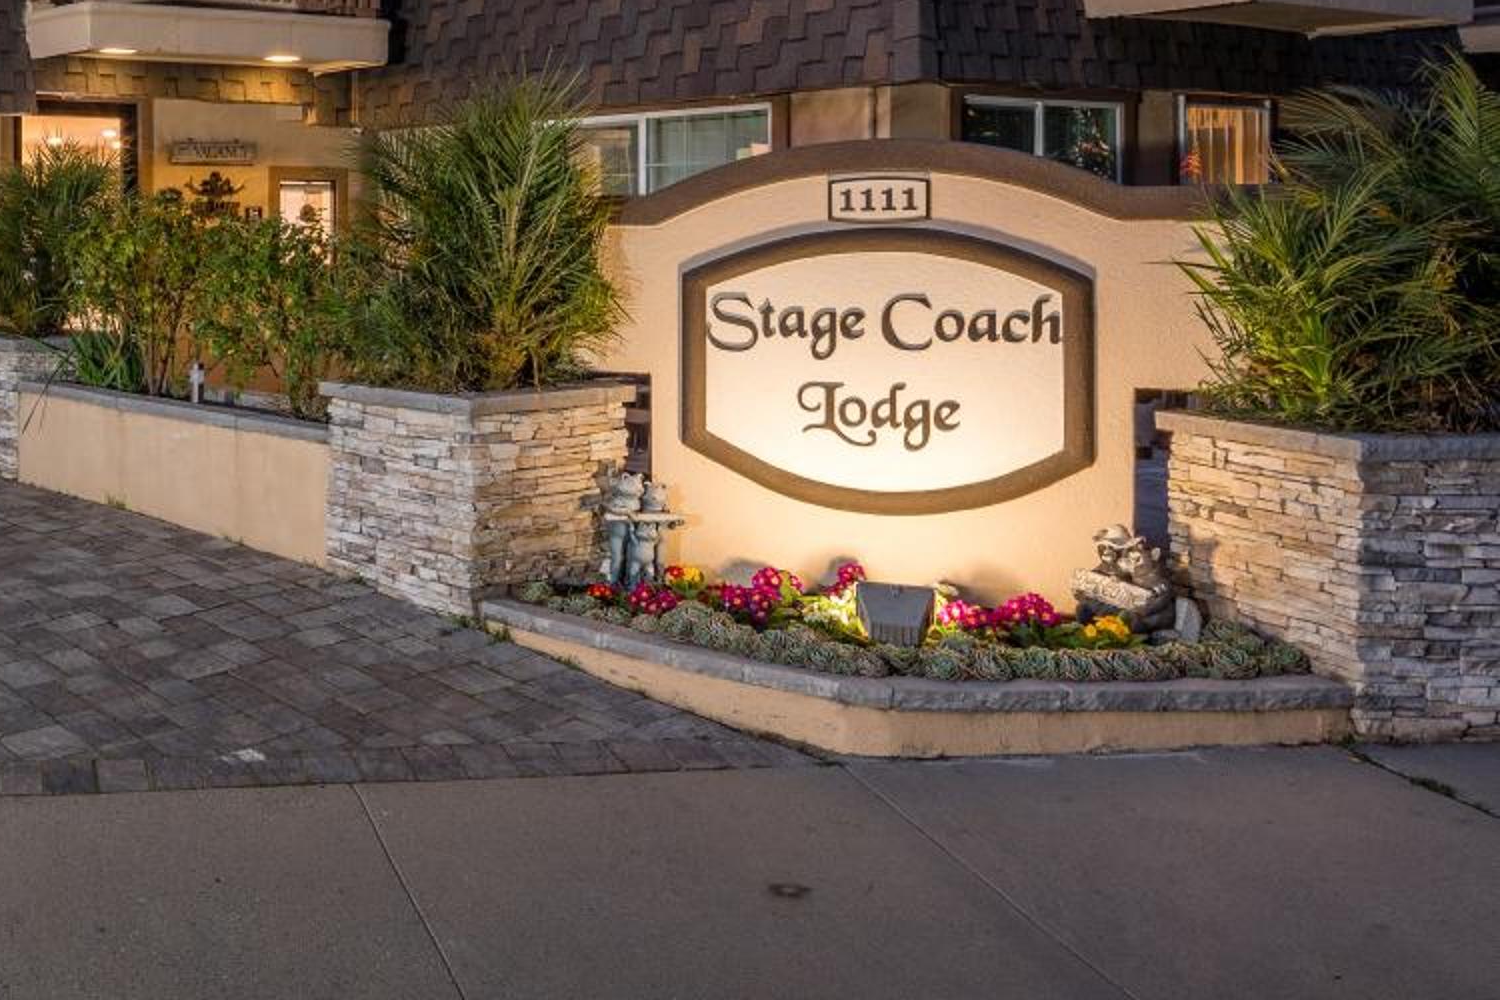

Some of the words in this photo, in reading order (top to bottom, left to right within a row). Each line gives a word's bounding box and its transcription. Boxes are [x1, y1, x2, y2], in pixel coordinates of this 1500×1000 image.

[839, 187, 918, 212] 1111
[707, 291, 866, 360] Stage
[881, 293, 1063, 351] Coach
[797, 381, 961, 452] Lodge
